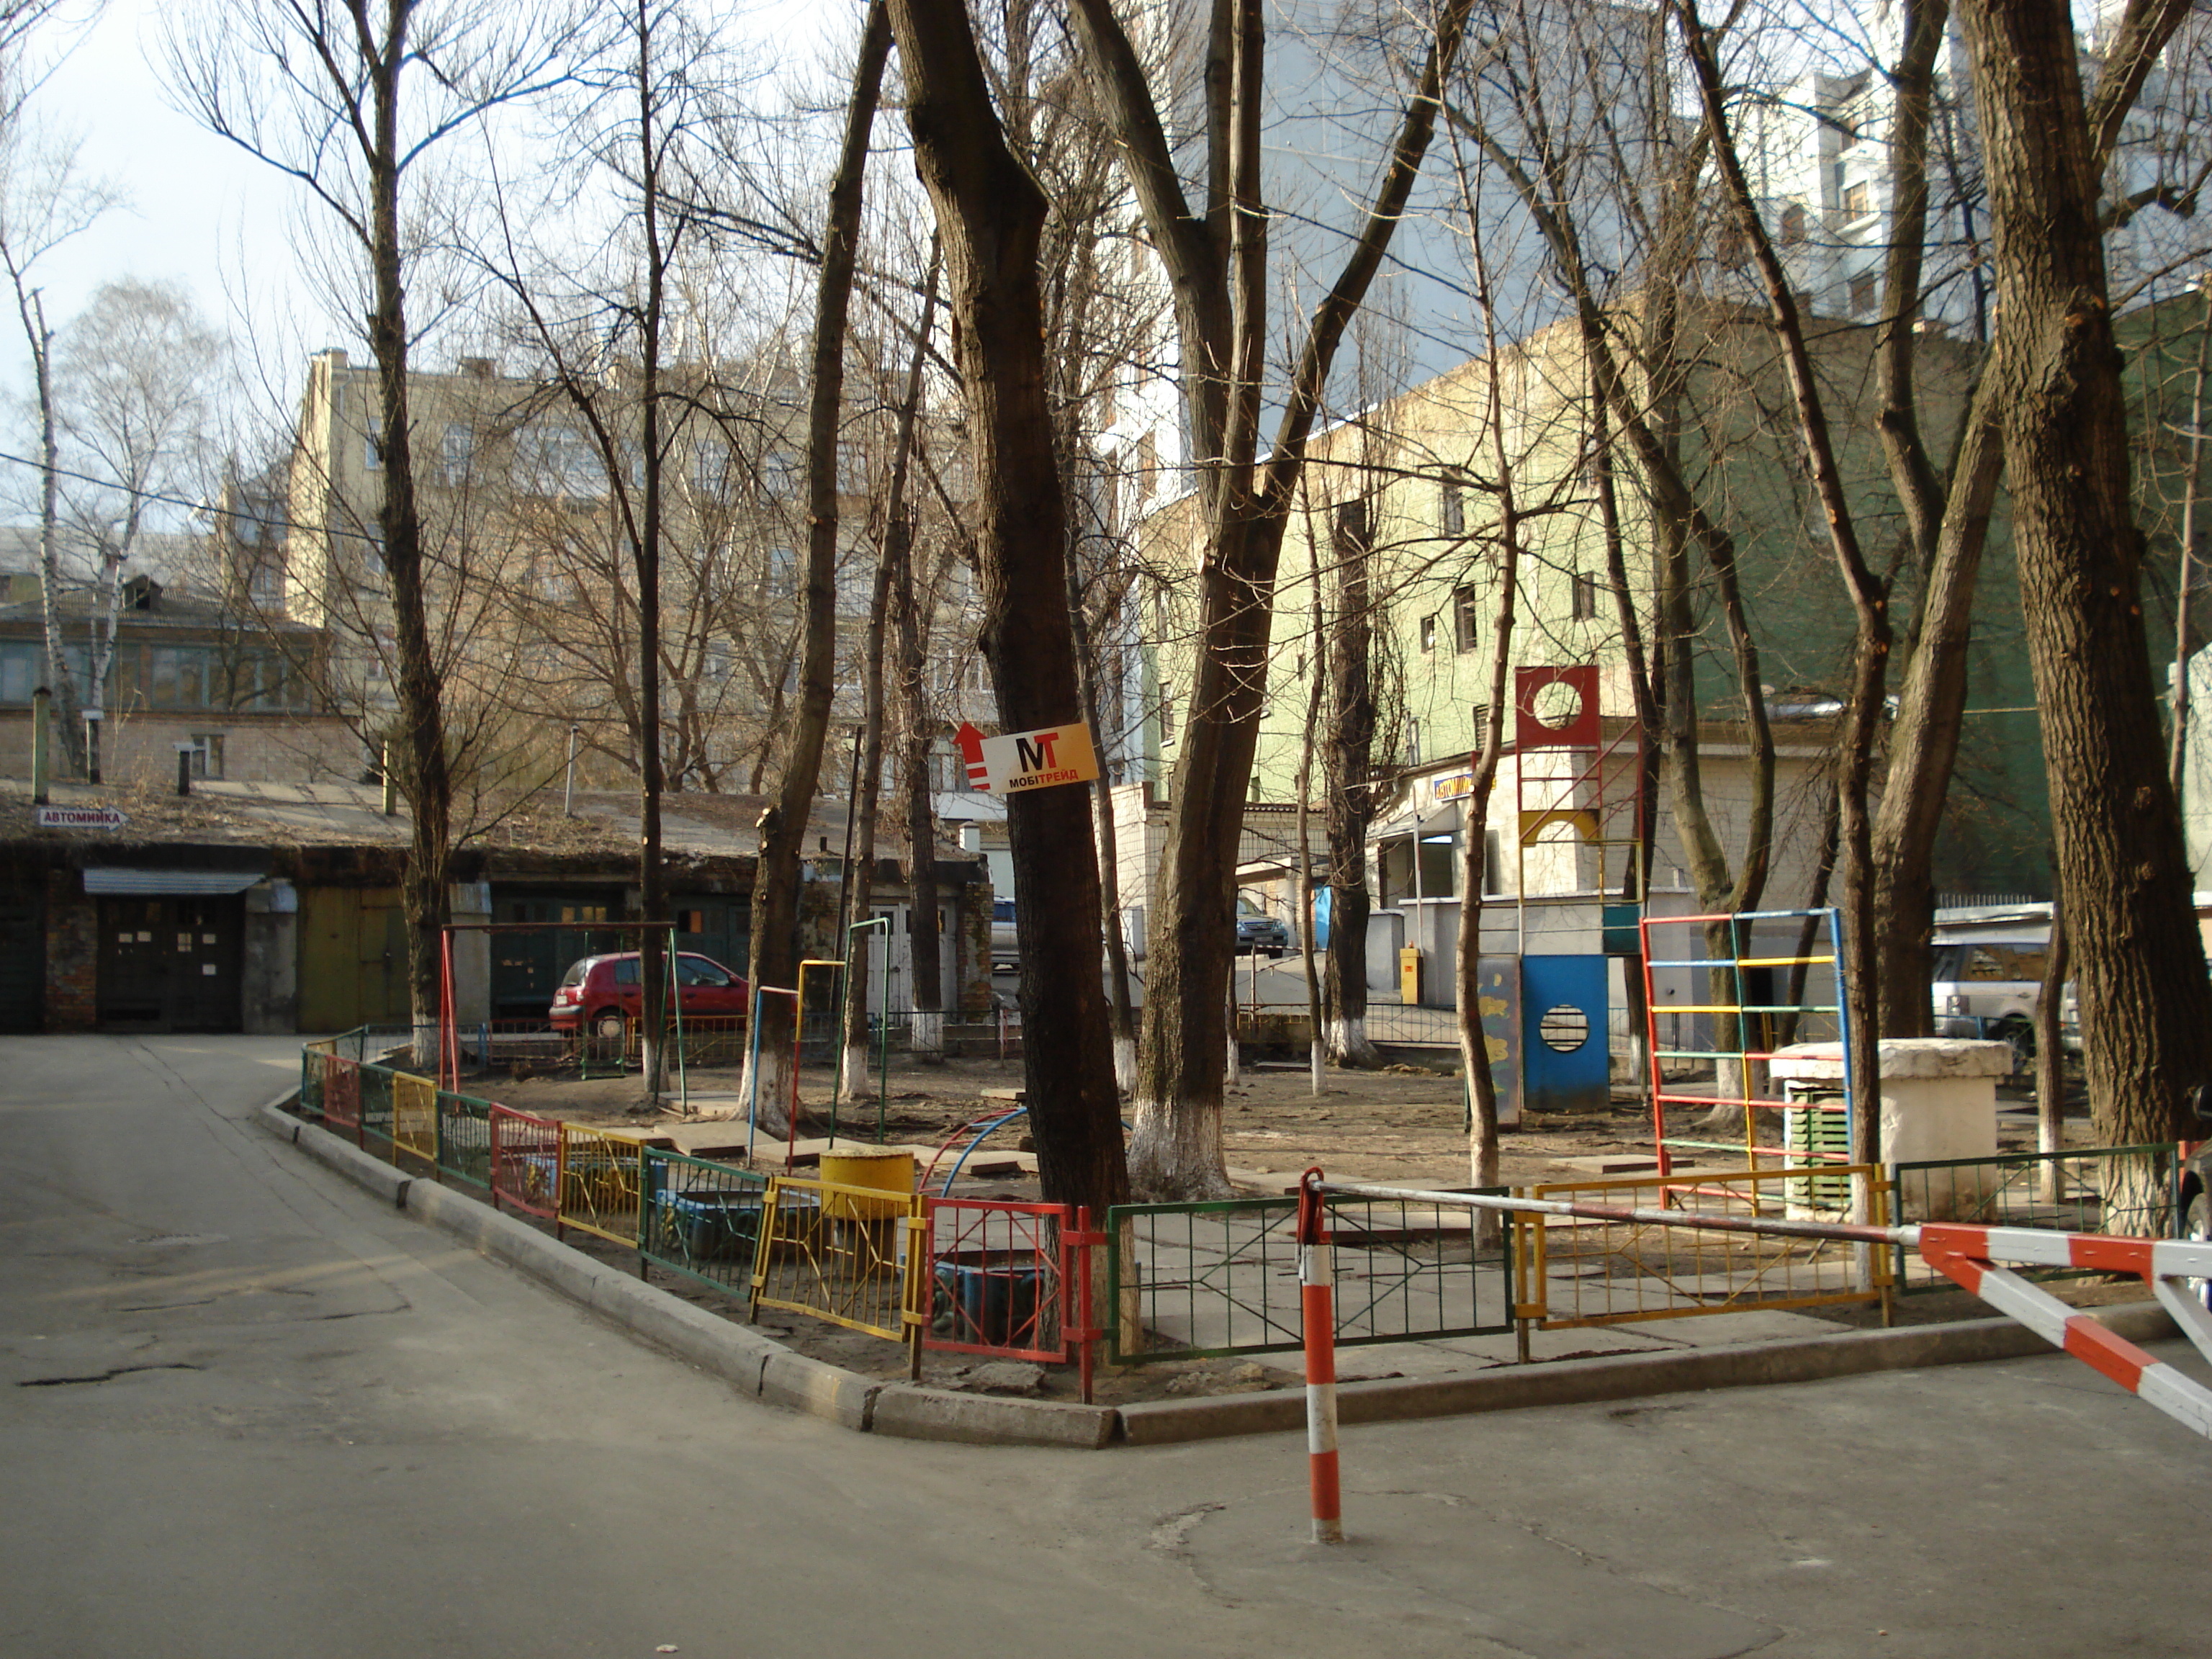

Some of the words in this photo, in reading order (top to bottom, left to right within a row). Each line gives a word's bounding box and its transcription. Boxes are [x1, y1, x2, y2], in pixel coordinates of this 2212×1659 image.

[1010, 769, 1079, 788] МОБІТРЕЙД
[1436, 775, 1472, 799] АВТОМИЙК
[45, 811, 121, 824] АВТОМИЙКА
